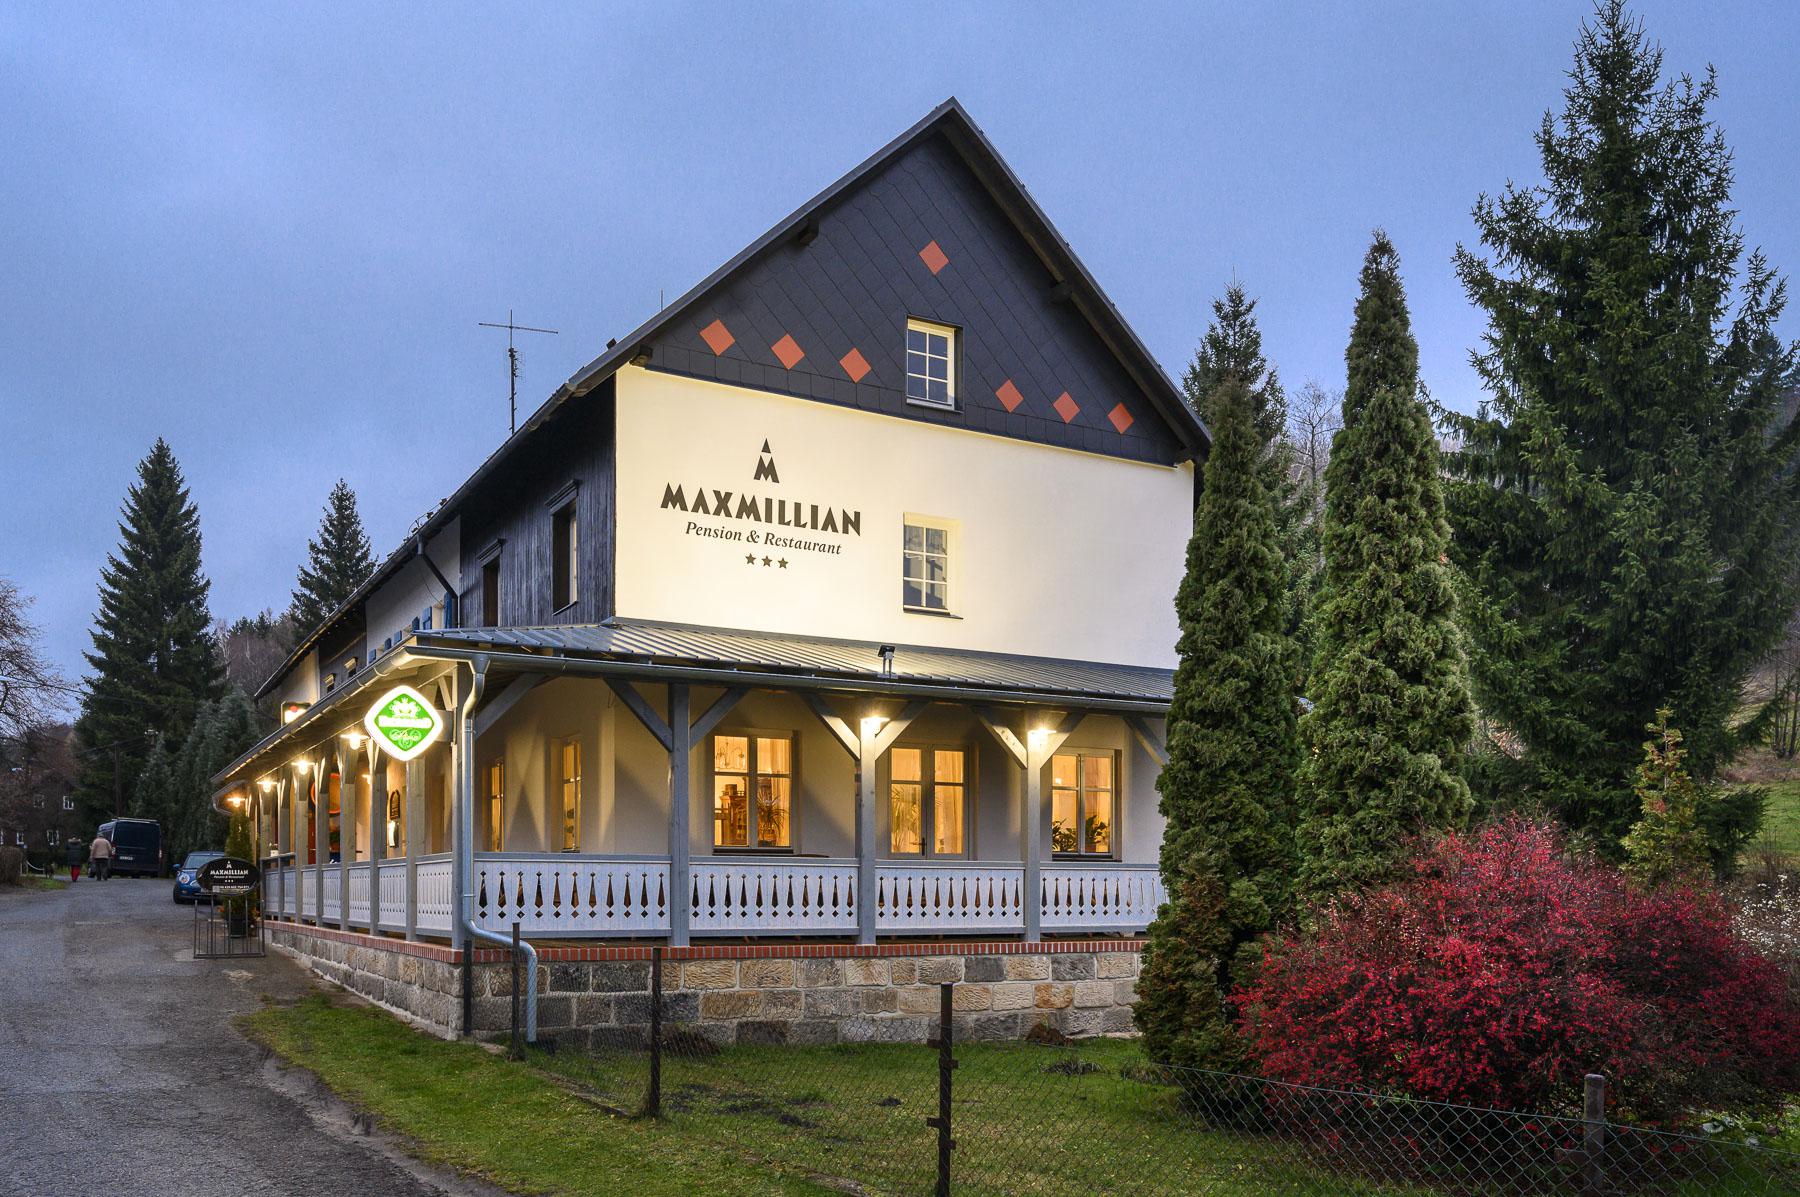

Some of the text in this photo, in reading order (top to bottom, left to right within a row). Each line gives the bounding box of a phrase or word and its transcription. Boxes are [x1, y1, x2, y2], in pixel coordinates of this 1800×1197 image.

[660, 482, 861, 537] MAXMILLIAN
[686, 521, 842, 555] Pension & Restaurant
